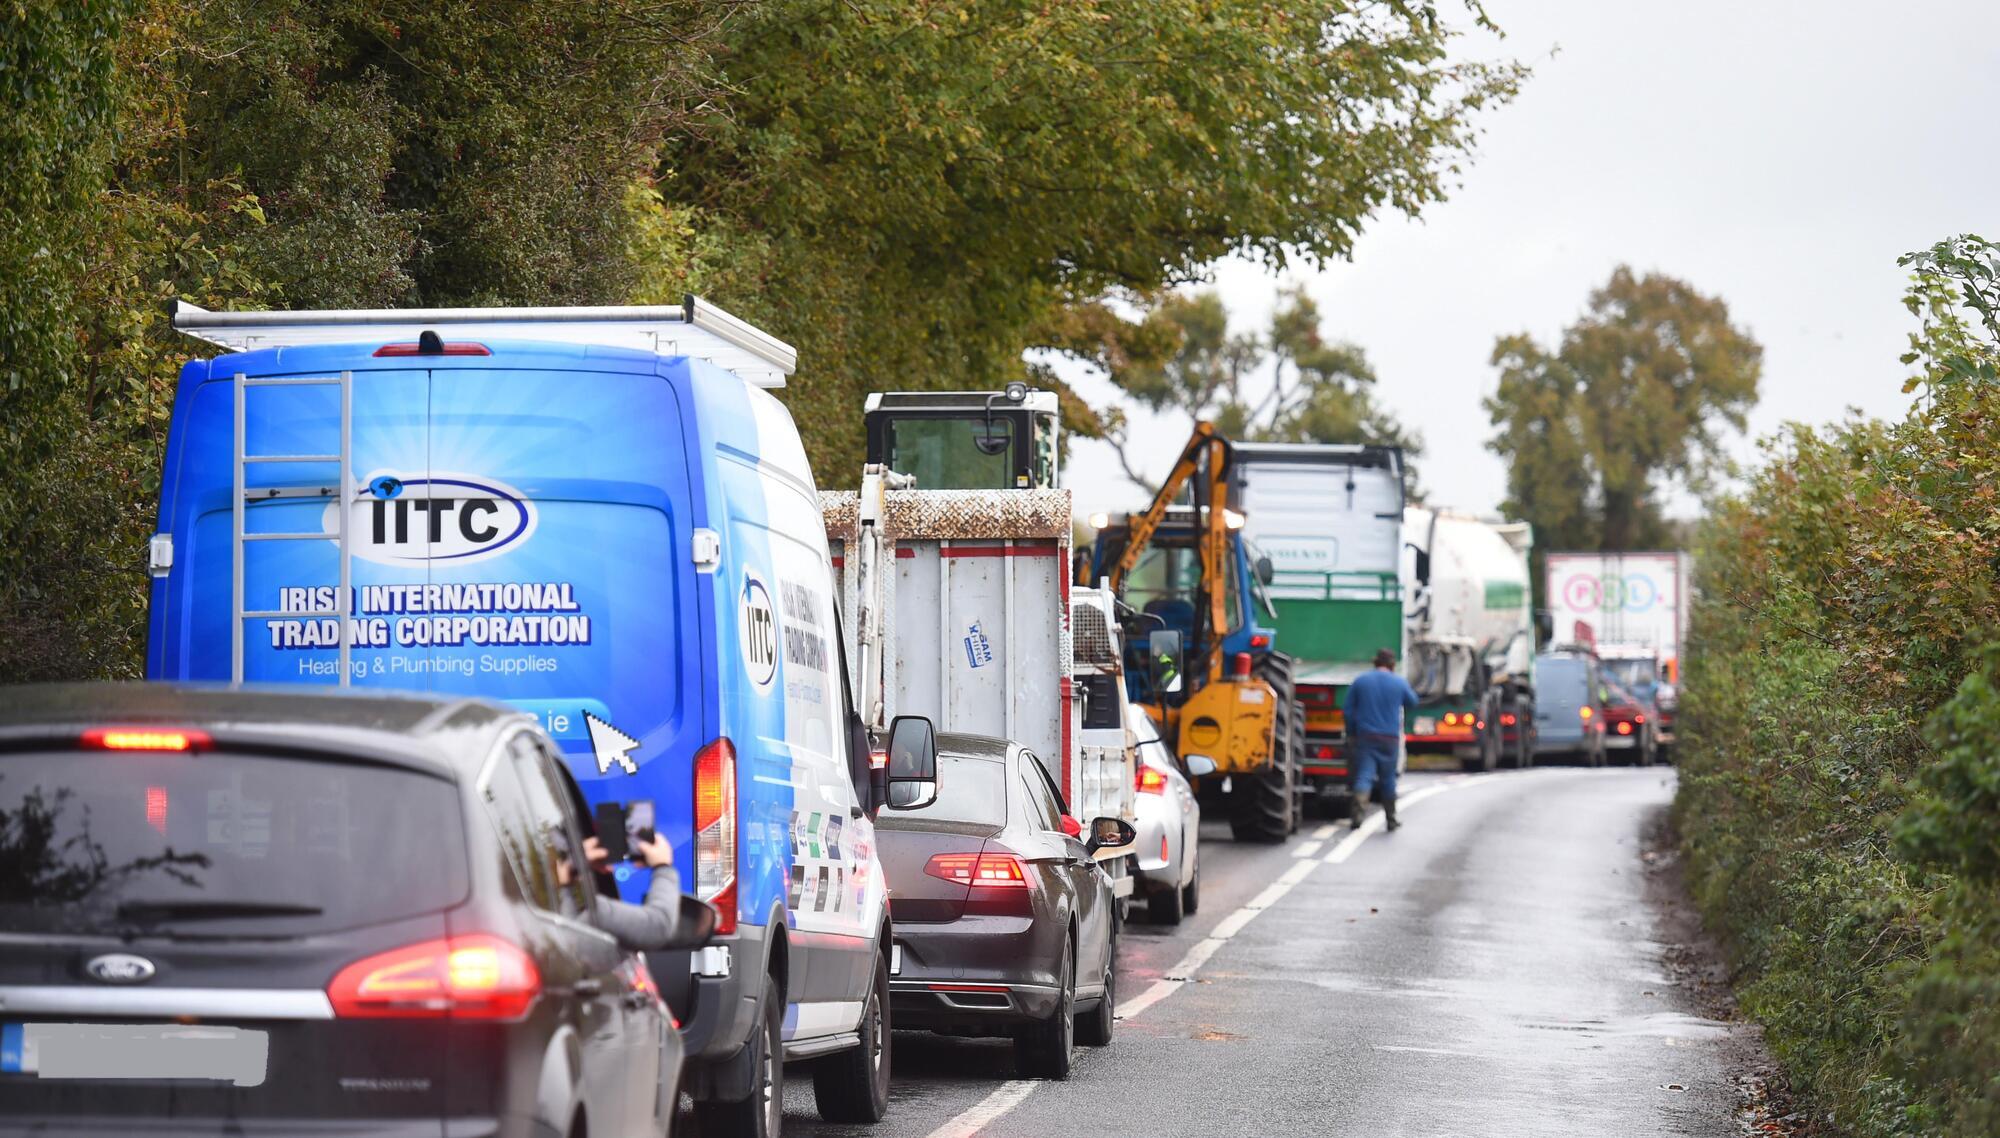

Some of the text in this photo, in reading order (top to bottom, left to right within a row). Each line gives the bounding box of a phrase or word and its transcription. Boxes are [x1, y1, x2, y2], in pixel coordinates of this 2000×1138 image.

[373, 498, 499, 544] IITC
[361, 583, 580, 613] INTERNATIONAL
[267, 615, 591, 649] TRADNG CORPORATION
[747, 606, 773, 666] IITC
[299, 653, 557, 678] Heatng & Plumbing Supplies
